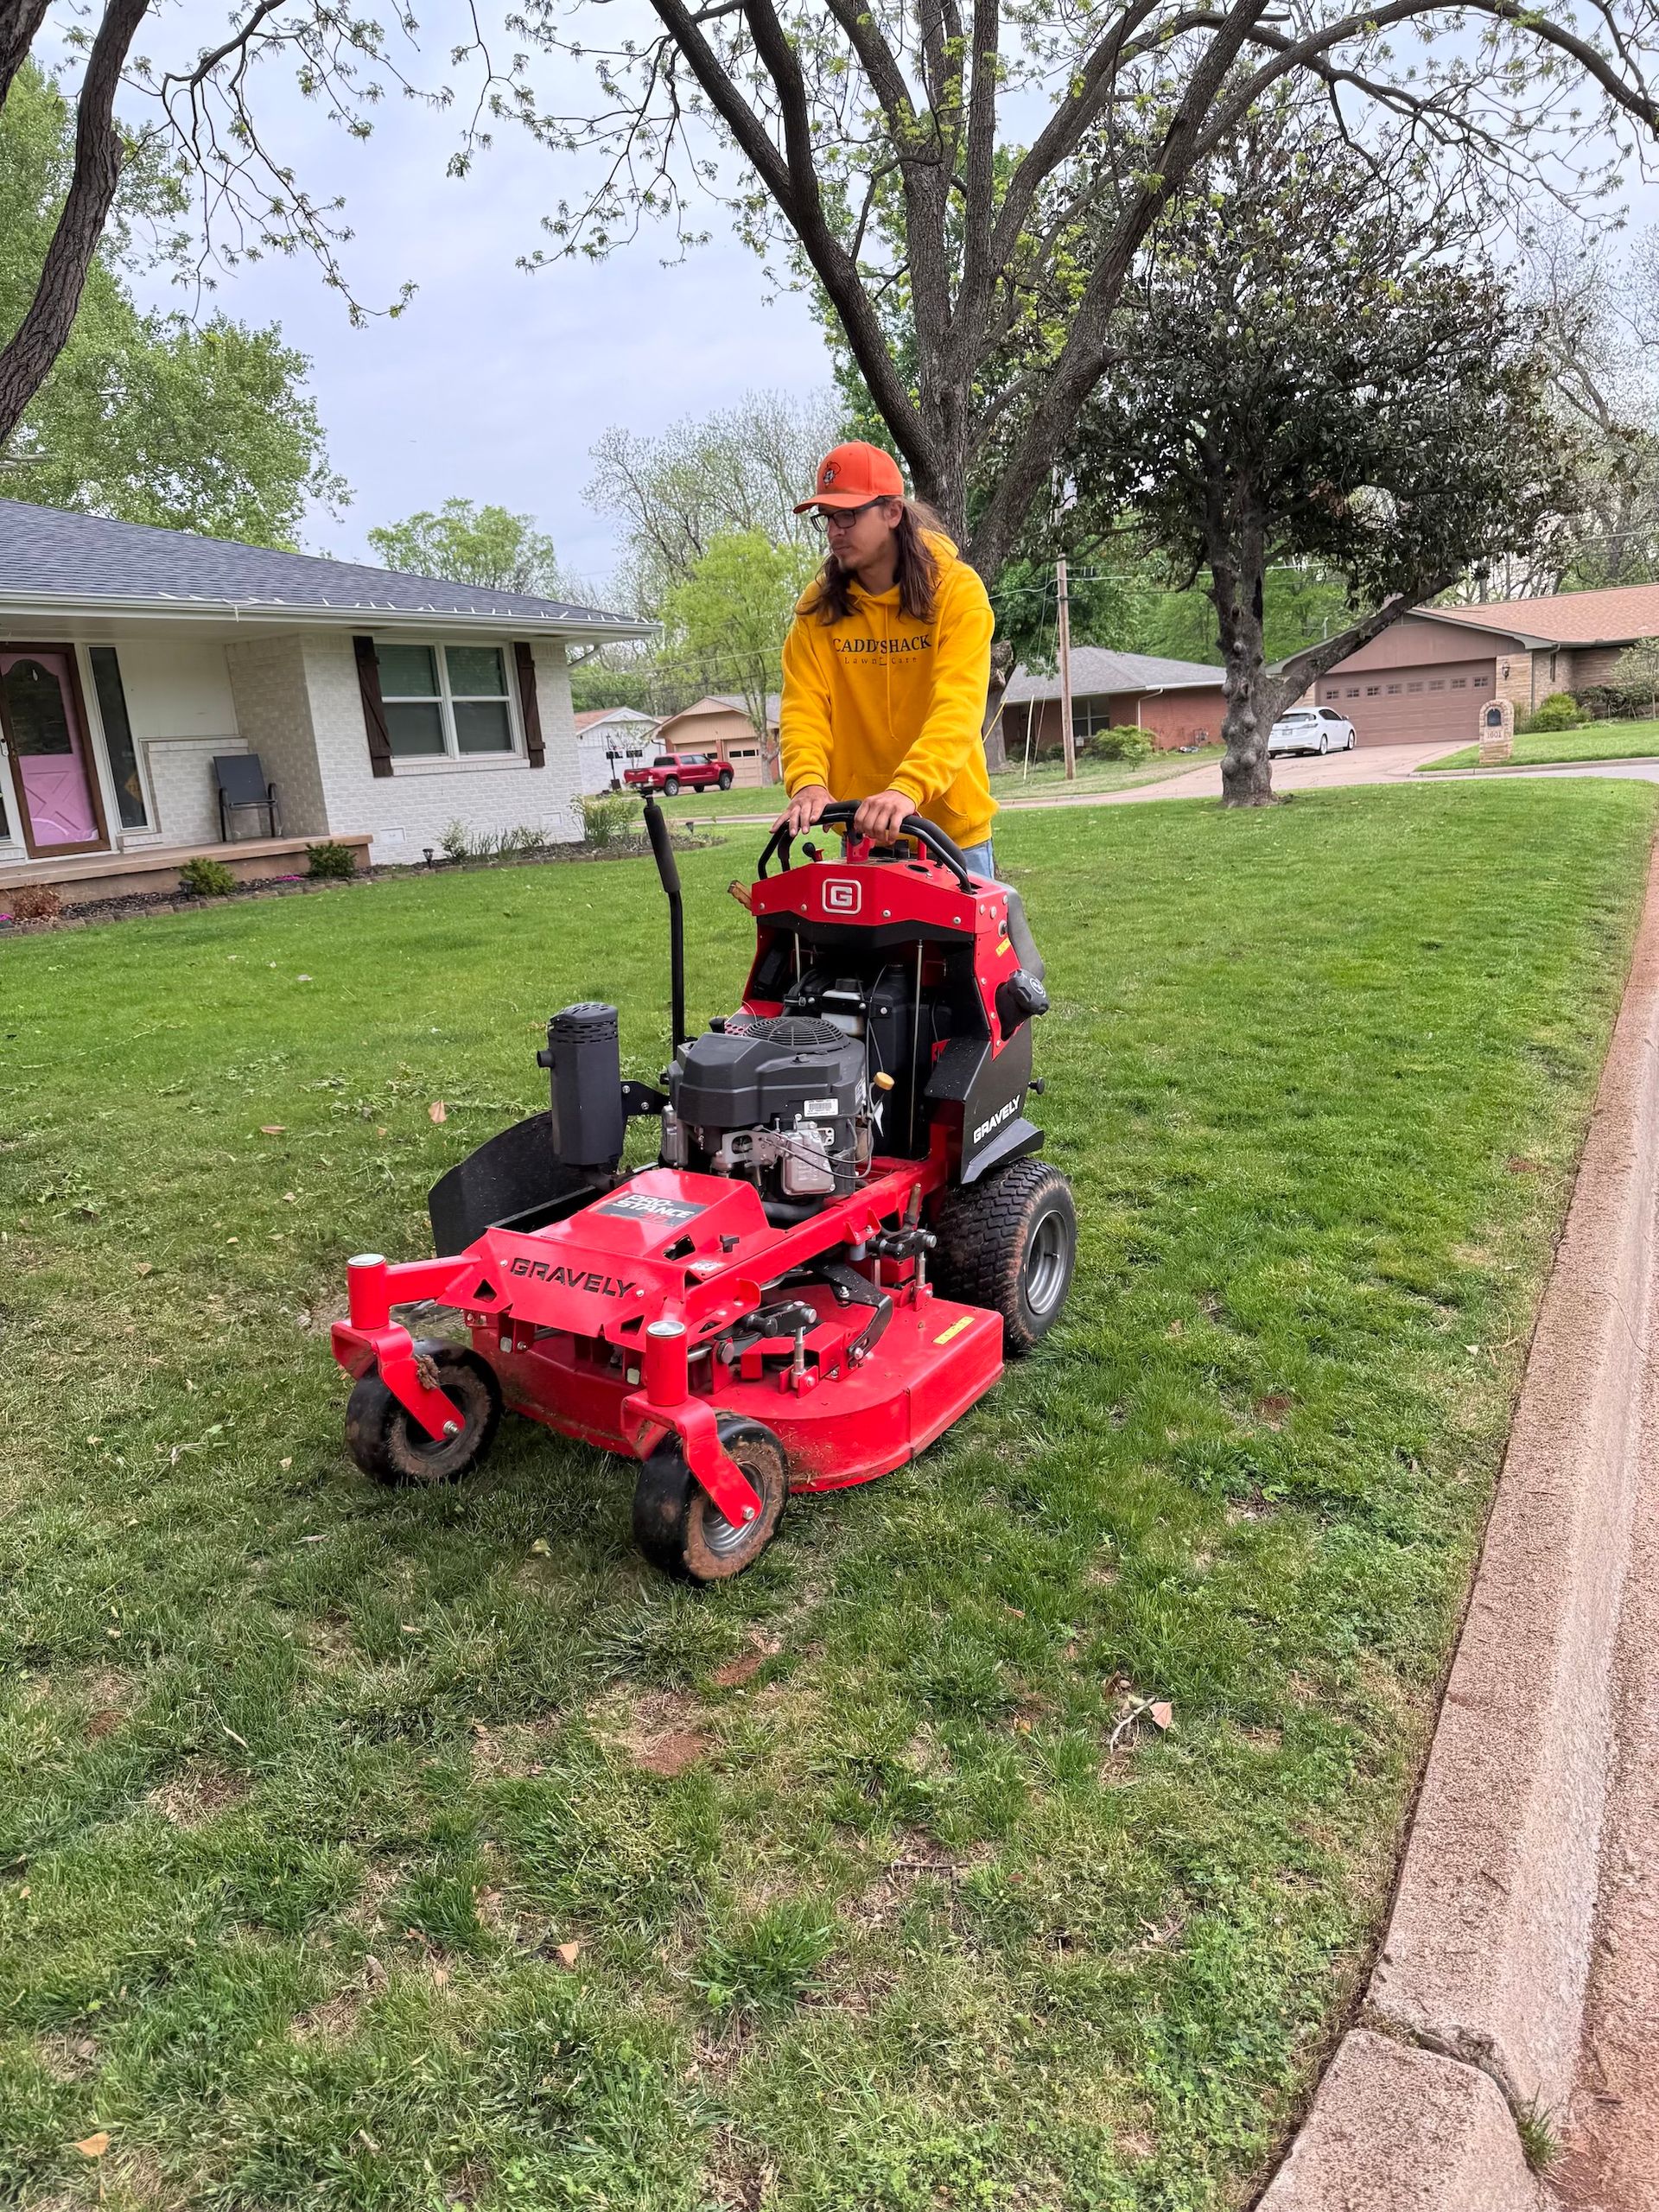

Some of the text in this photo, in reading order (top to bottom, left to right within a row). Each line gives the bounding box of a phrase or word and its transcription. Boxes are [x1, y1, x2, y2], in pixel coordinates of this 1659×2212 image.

[830, 886, 853, 906] G
[973, 1094, 1020, 1144] GRAVELY
[612, 1199, 695, 1218] STANCE
[510, 1257, 637, 1298] GRAVELY
